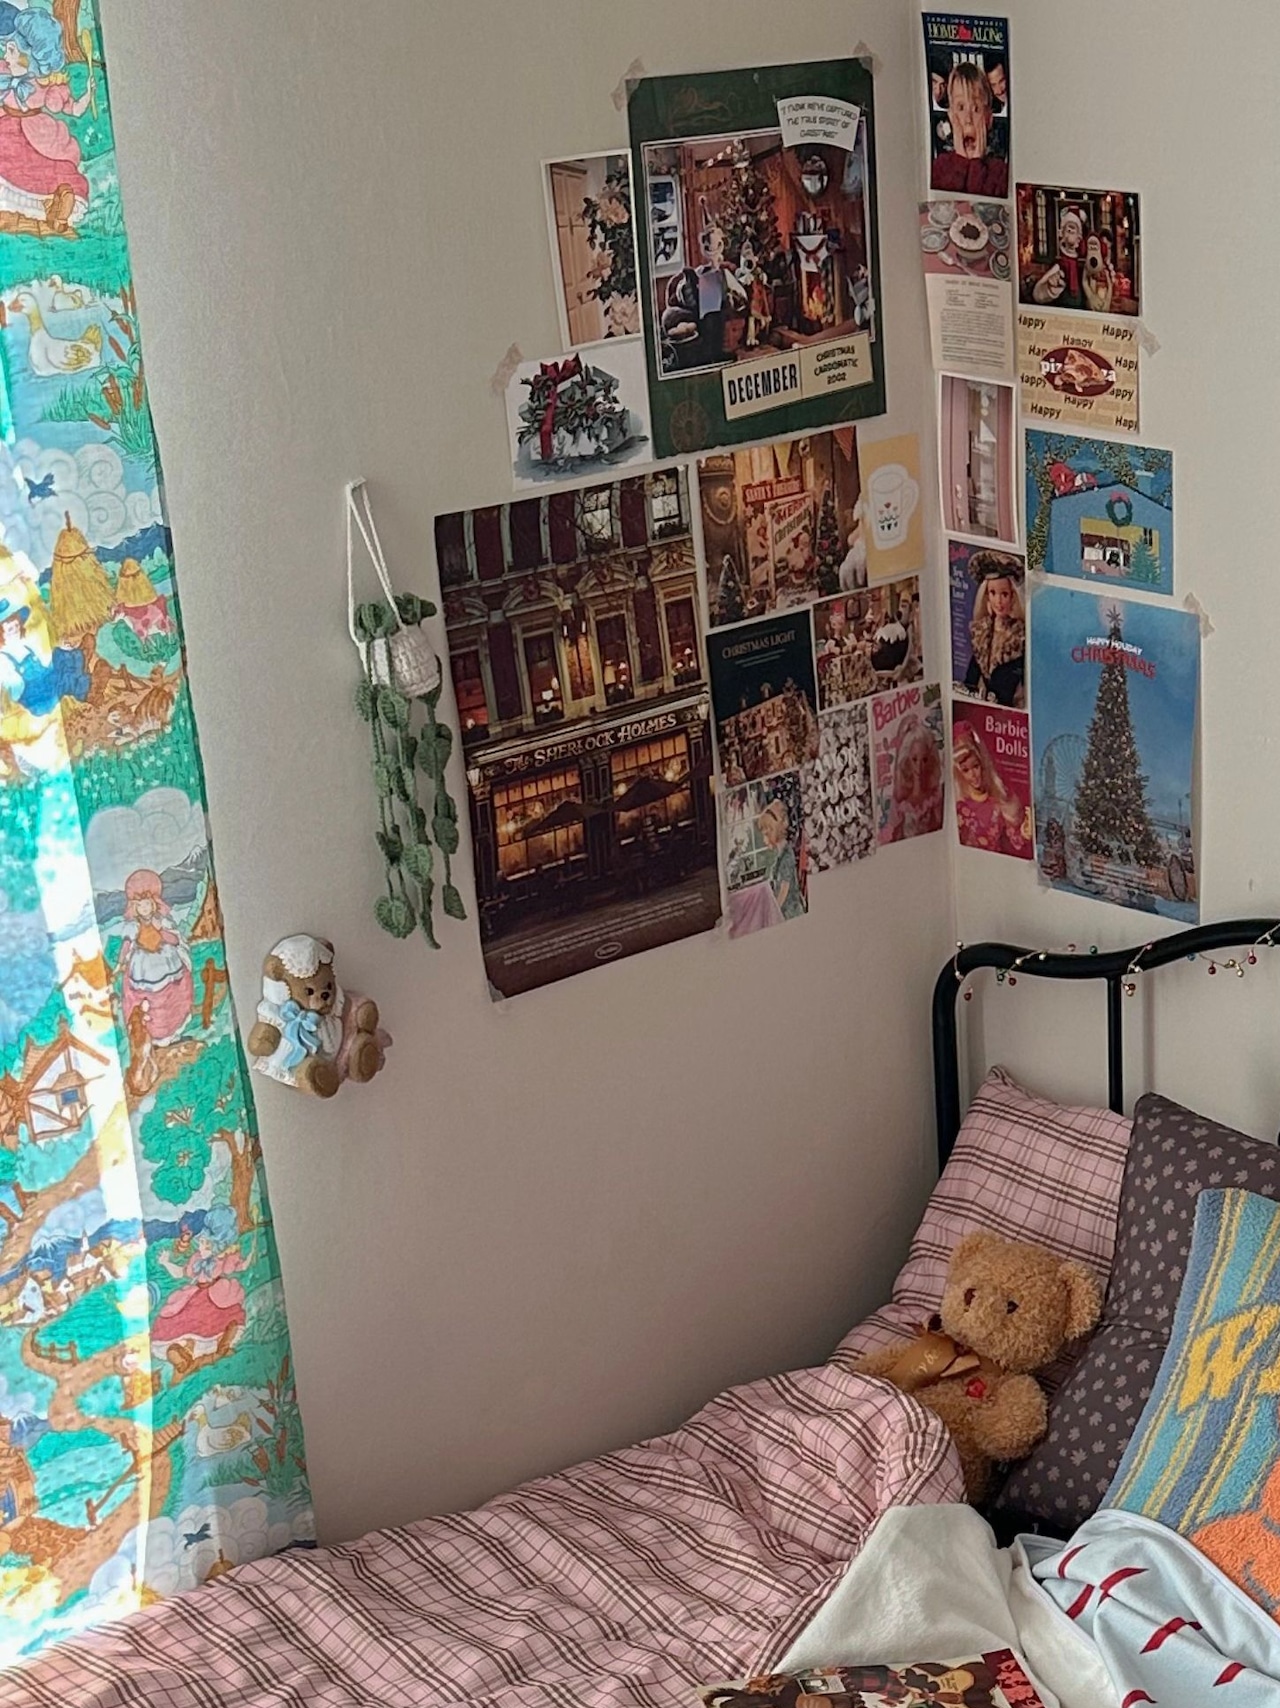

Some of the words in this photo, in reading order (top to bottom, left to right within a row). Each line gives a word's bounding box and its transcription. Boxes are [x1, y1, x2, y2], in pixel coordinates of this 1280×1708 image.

[1102, 324, 1135, 341] Happy
[728, 363, 798, 406] DECEMBER
[1030, 402, 1062, 419] Happy
[722, 637, 770, 660] CHRISTMAS
[770, 629, 796, 646] LIGHT
[1071, 645, 1157, 680] CHRISTMAS
[872, 687, 921, 731] Barbie
[533, 730, 615, 767] SHERLOCK
[617, 713, 677, 744] HOLMES
[985, 715, 1028, 739] Barbie
[996, 737, 1028, 758] Dolls
